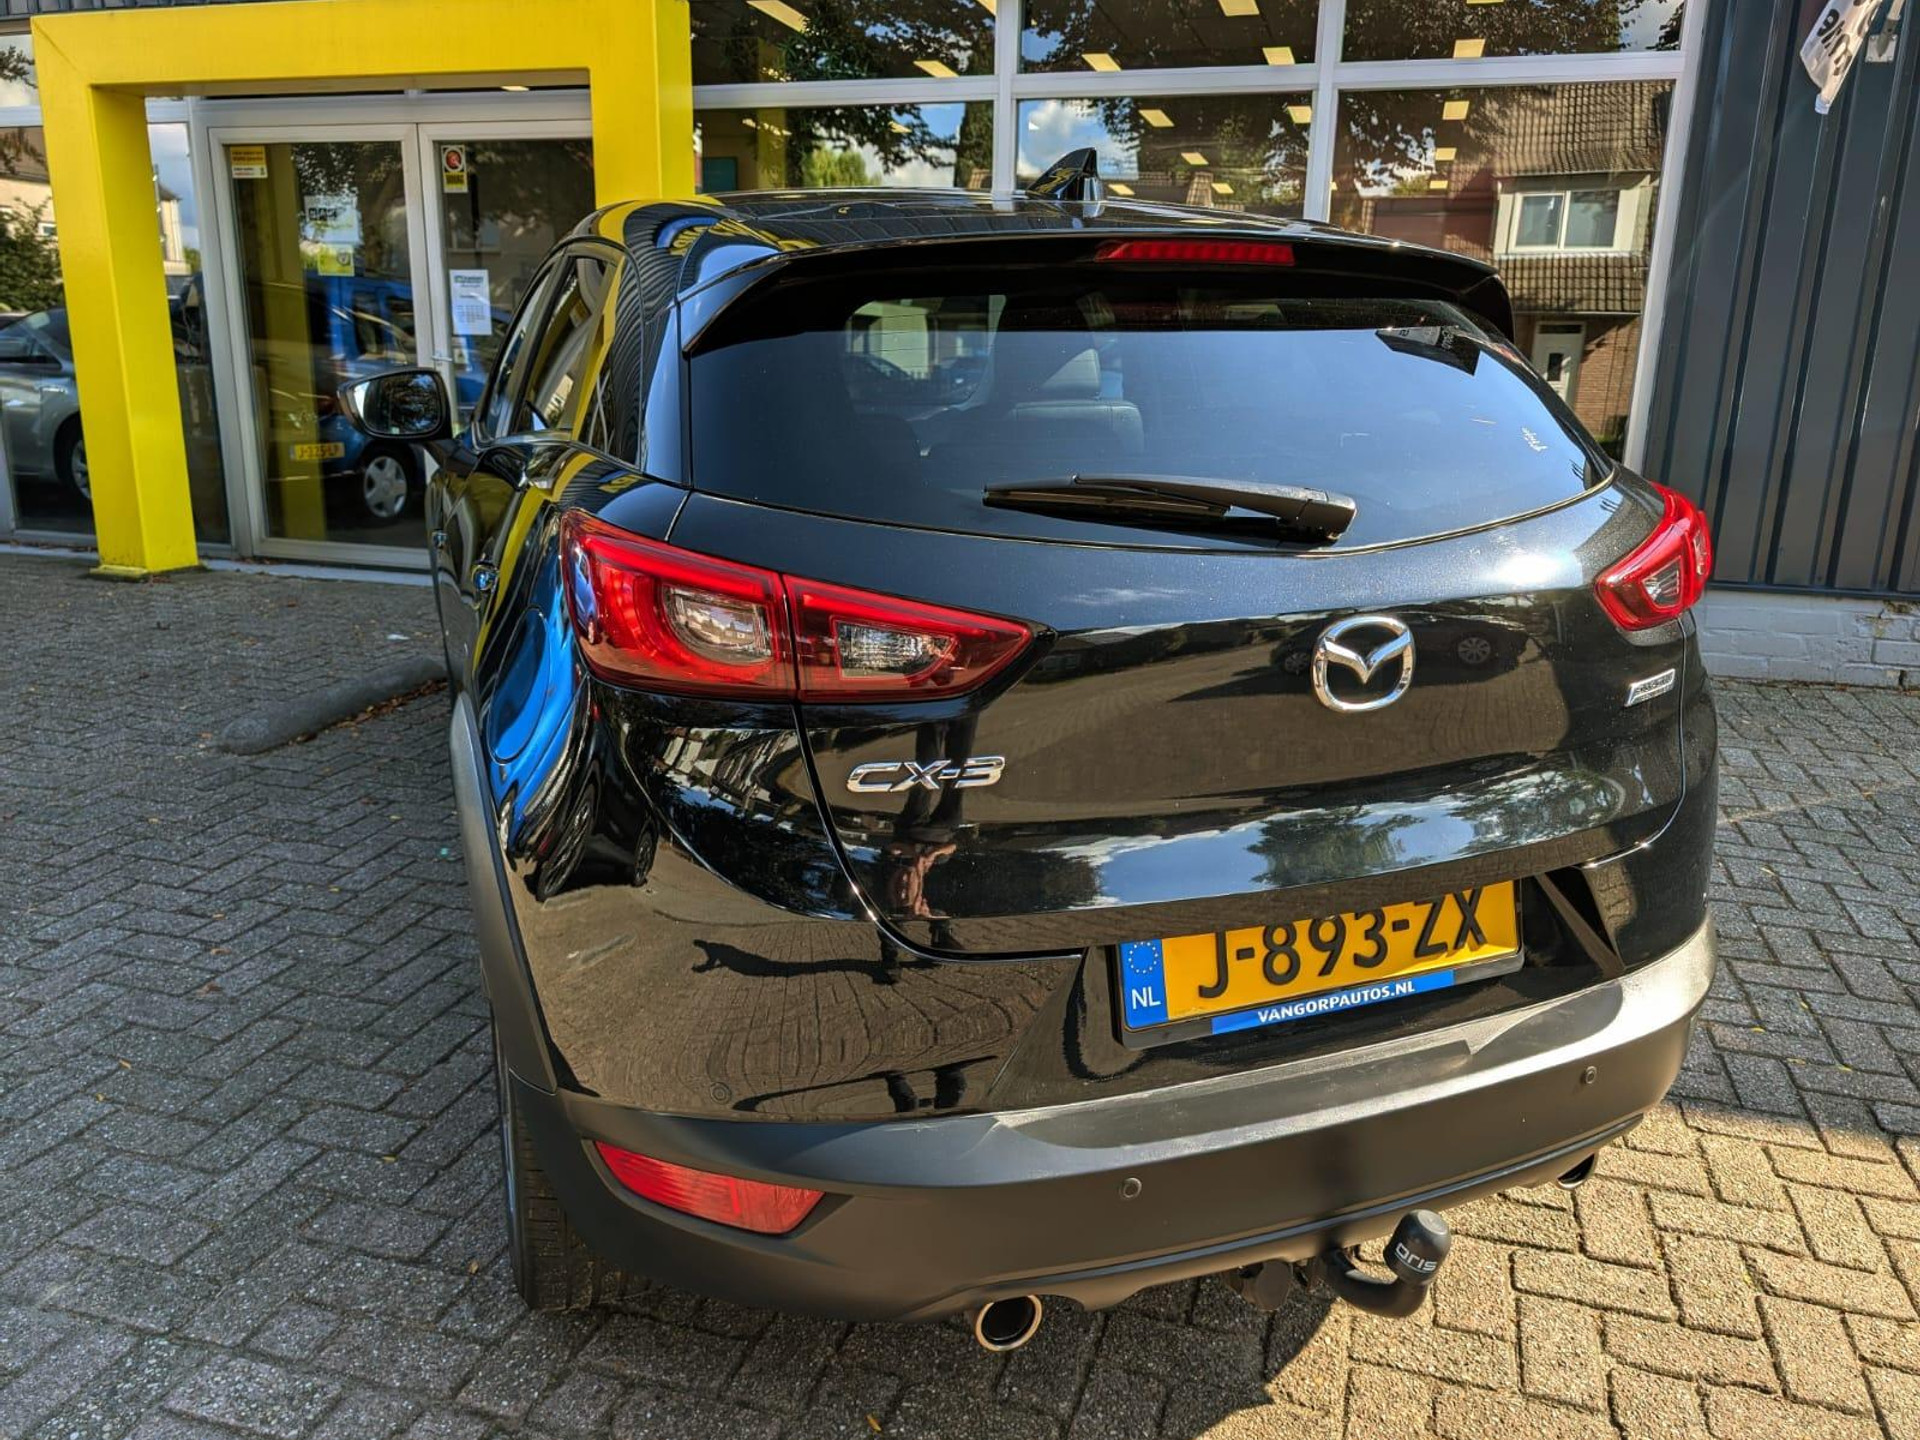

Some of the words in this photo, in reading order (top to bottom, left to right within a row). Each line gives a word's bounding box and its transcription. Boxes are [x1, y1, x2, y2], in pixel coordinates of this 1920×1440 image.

[847, 755, 1006, 793] CX-3
[1198, 885, 1488, 999] J-893-ZX
[1131, 986, 1162, 1010] NL
[1257, 980, 1416, 1024] VANGORPAUTOS.NL
